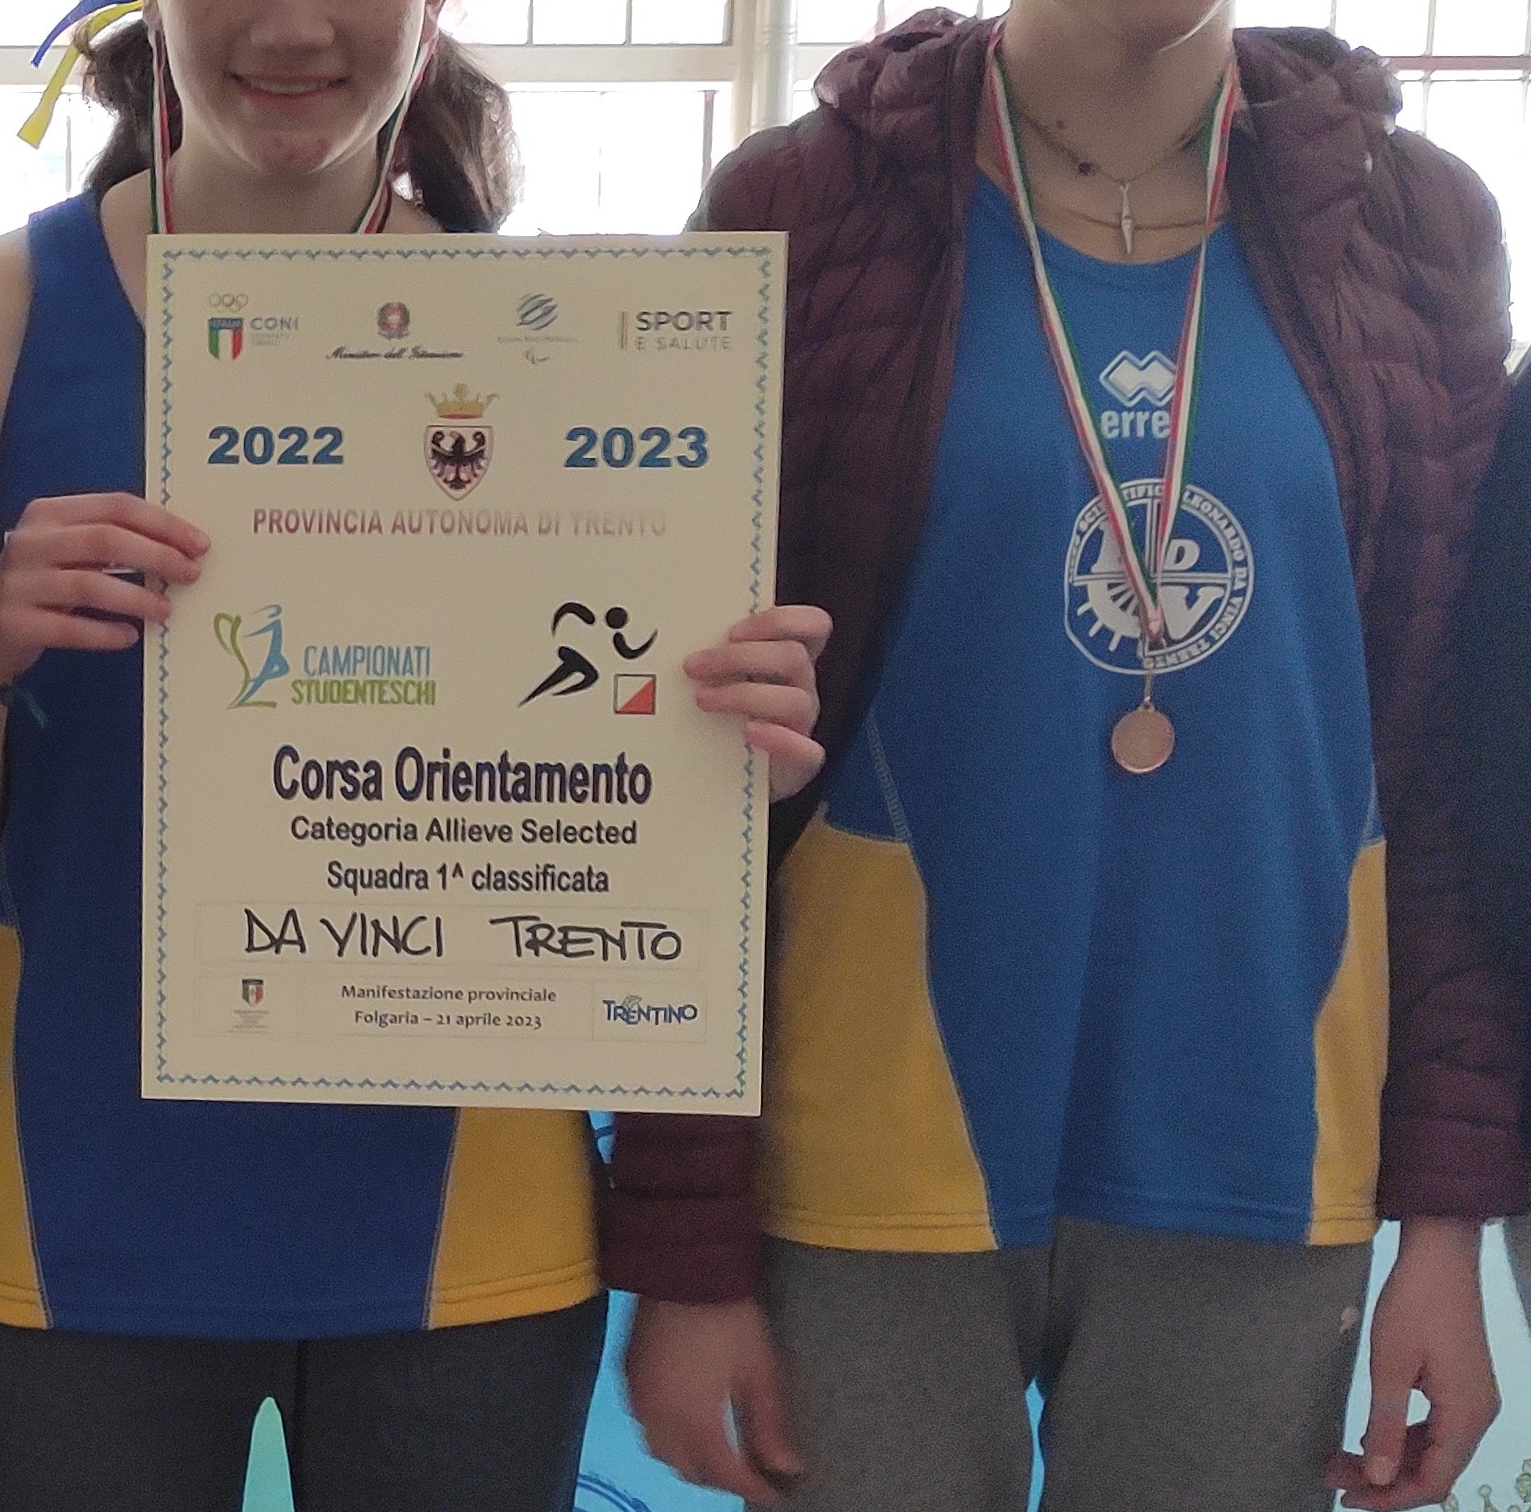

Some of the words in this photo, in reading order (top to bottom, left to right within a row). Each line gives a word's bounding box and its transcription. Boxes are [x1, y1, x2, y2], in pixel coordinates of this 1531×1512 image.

[250, 316, 299, 331] CONI
[635, 310, 733, 332] SPORT
[634, 336, 647, 350] E
[657, 336, 732, 351] SALUTE
[1100, 410, 1171, 439] erre
[207, 426, 344, 466] 2022
[564, 426, 710, 469] 2023
[252, 508, 383, 536] PROVINCIA
[391, 508, 529, 537] AUTONOMA
[538, 509, 561, 537] DI
[572, 509, 667, 538] TRENTO
[303, 644, 431, 678] CAMPIONATI
[290, 679, 437, 706] STUDENTESCHI
[273, 744, 383, 801] Corsa
[394, 745, 653, 805] Orientamento
[289, 816, 419, 847] Categoria
[425, 816, 513, 844] Allieve
[520, 819, 638, 845] Selected
[326, 861, 429, 896] Squadra
[471, 863, 610, 893] classificata
[243, 908, 307, 955] DA
[319, 913, 444, 958] VINCI
[489, 915, 683, 962] TRENTO
[341, 984, 464, 1002] Manifestazione
[468, 986, 557, 1005] provinciale
[354, 1008, 418, 1028] Folgaria
[436, 1015, 451, 1026] 21
[456, 1013, 501, 1029] aprile
[506, 1016, 543, 1030] 2023
[602, 999, 698, 1026] TRENTINO
